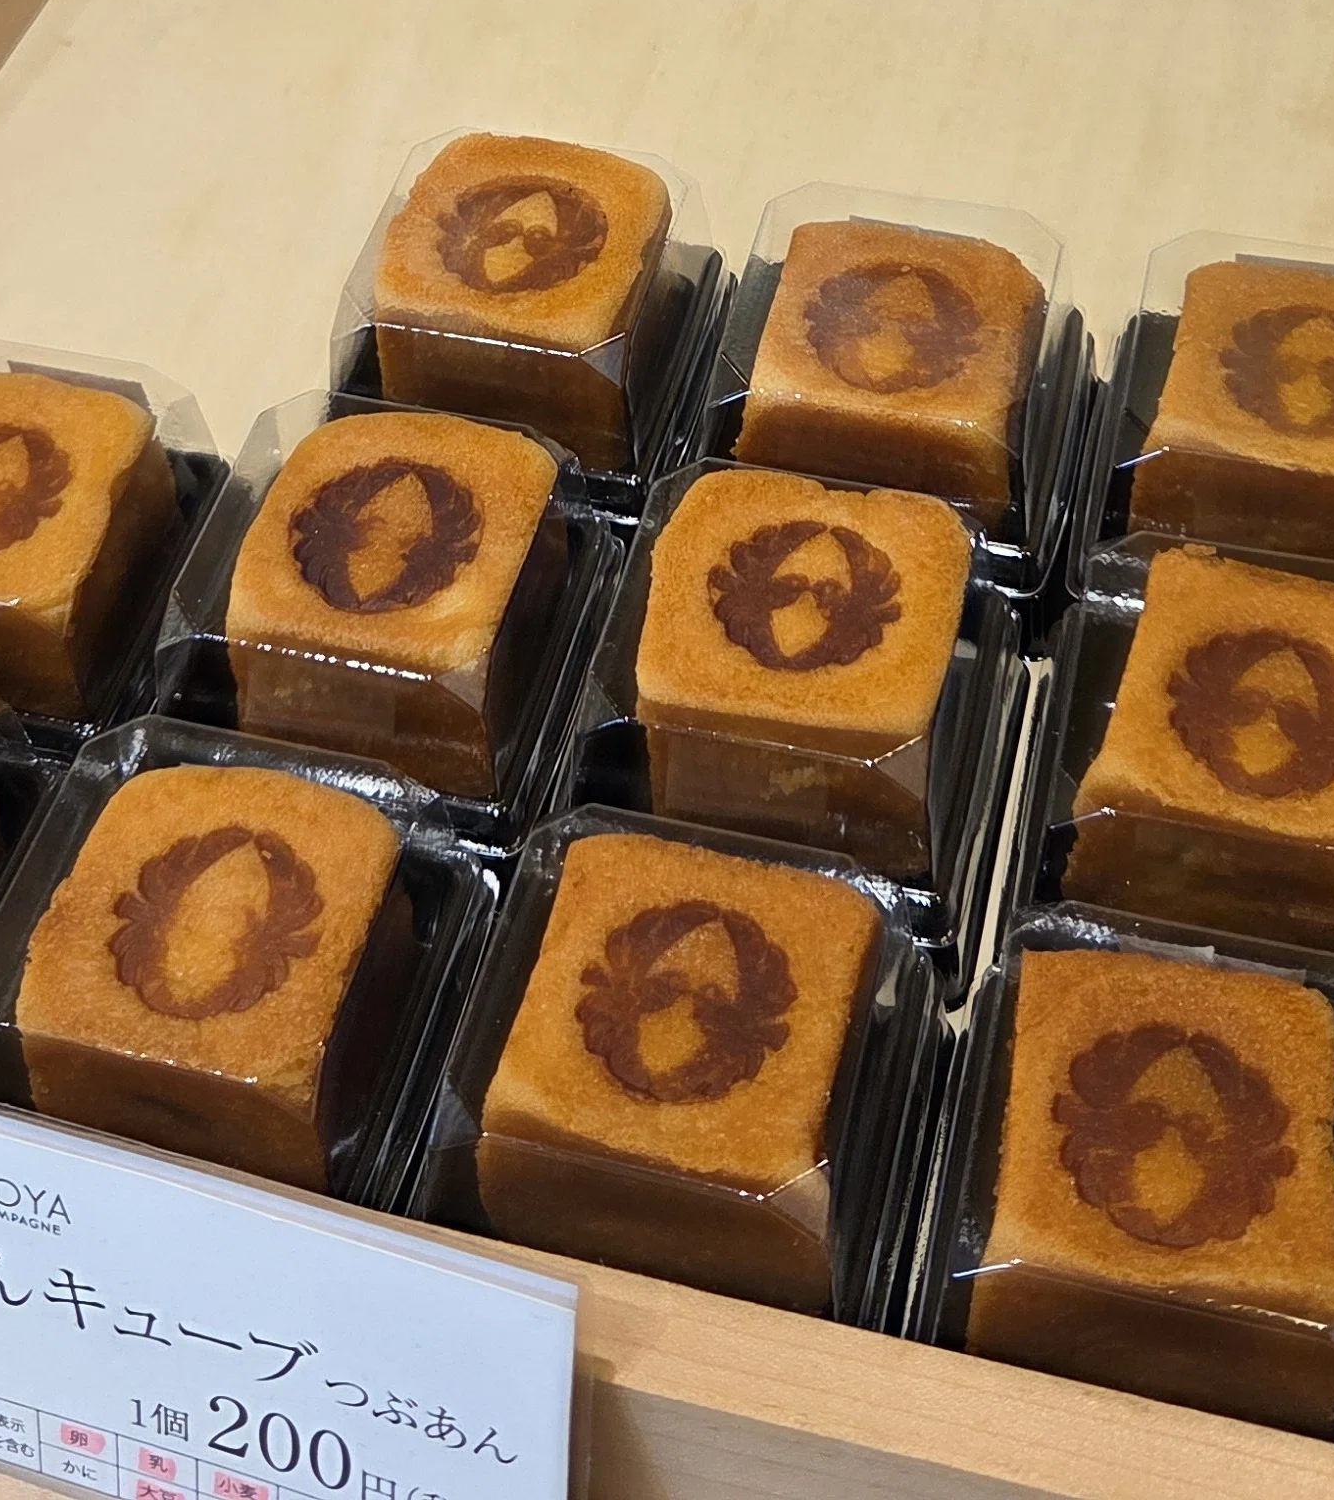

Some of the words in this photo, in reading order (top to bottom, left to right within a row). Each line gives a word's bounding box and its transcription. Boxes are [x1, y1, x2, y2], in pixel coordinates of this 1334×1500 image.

[129, 1398, 190, 1443] 1個
[325, 1379, 518, 1465] つぶあん
[69, 1429, 89, 1448] 卵
[61, 1459, 99, 1482] かに
[148, 1454, 169, 1473] 乳
[218, 1477, 259, 1500] 小麦
